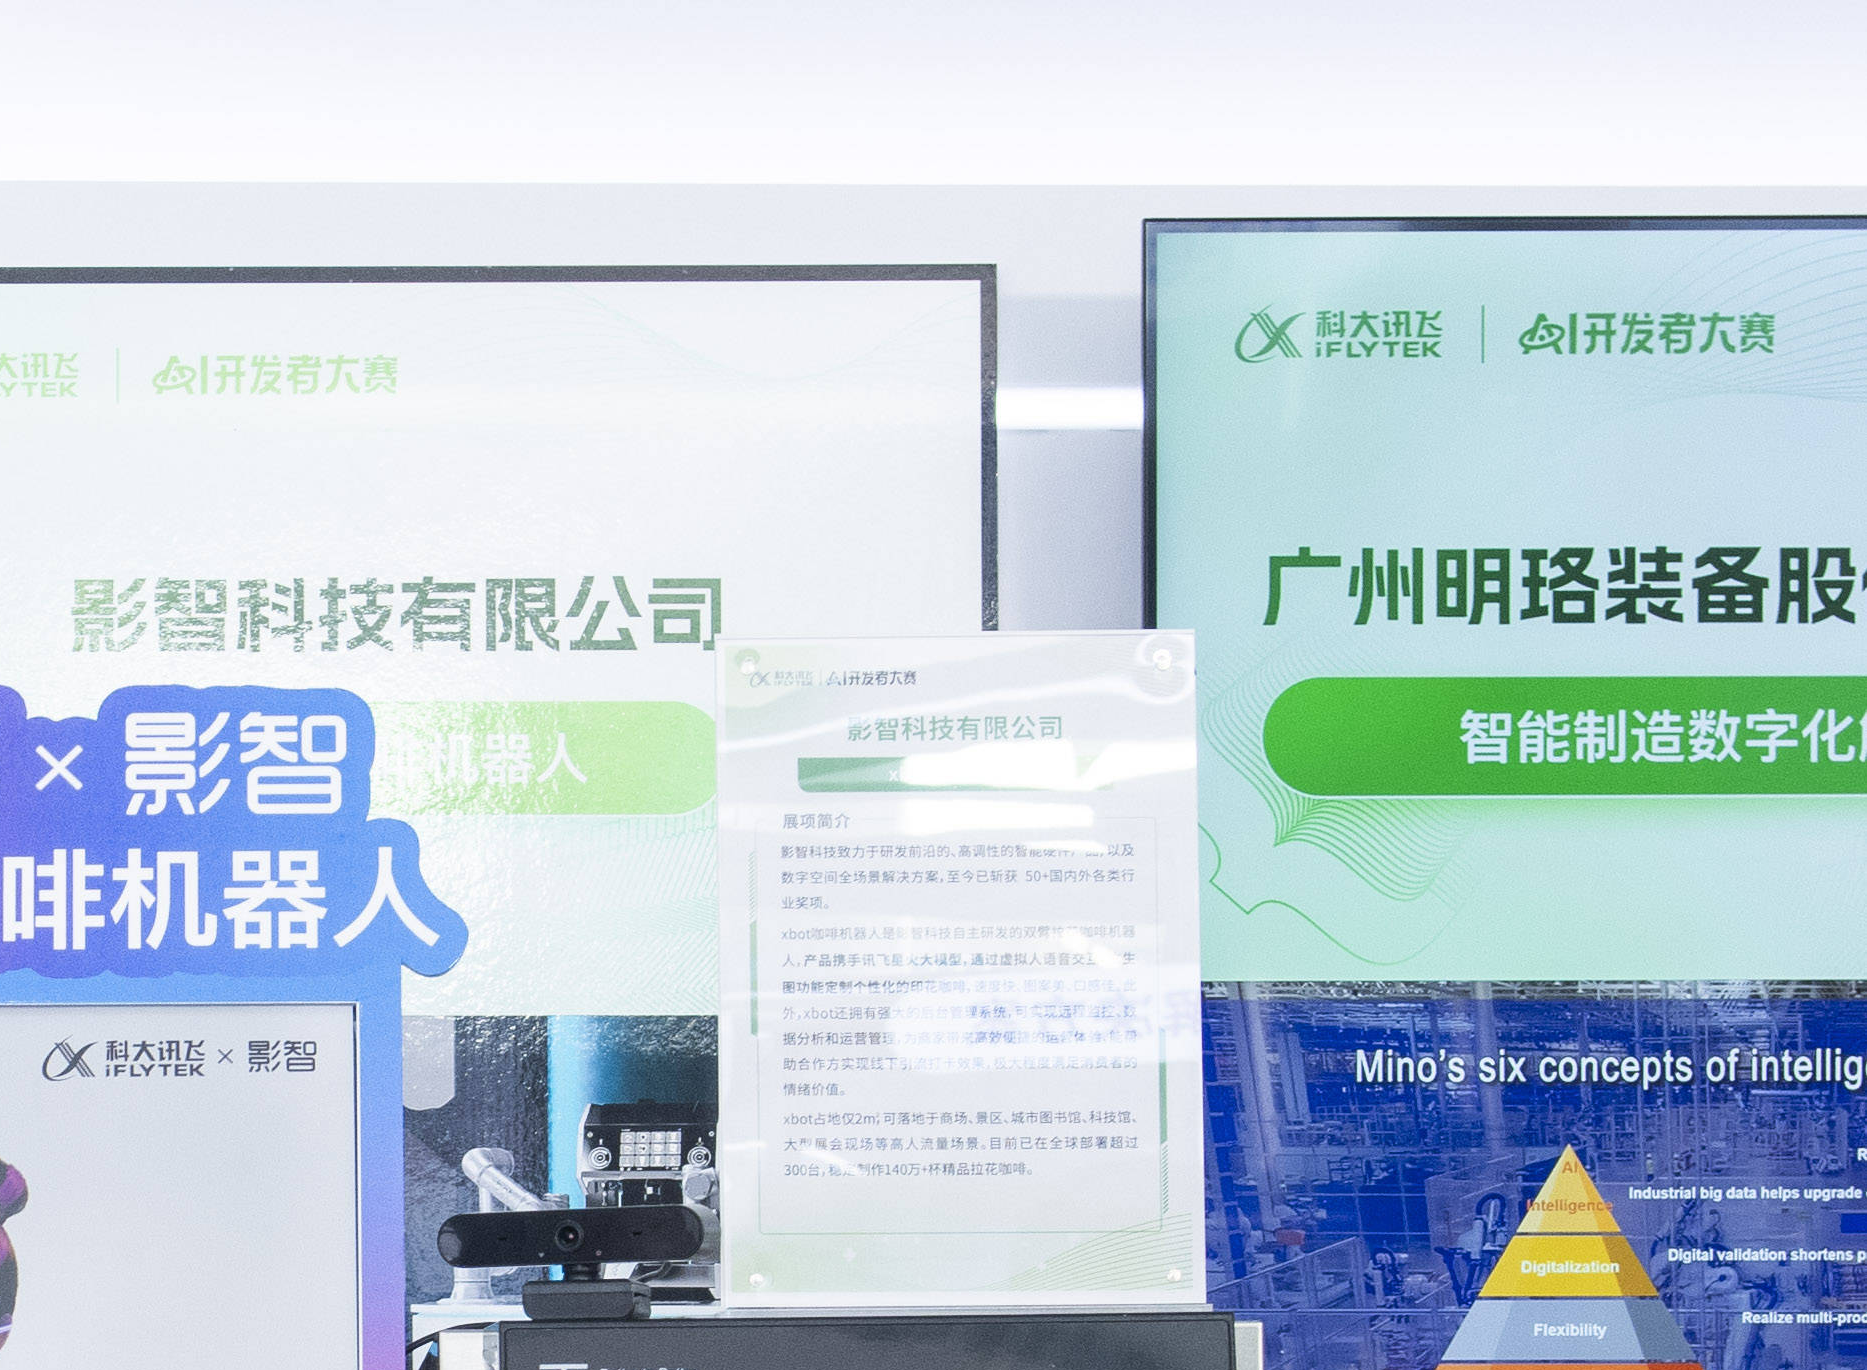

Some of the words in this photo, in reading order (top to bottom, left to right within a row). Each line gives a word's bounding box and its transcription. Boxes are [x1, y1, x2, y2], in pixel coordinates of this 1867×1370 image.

[1316, 310, 1443, 340] 科大讯飞
[1519, 312, 1776, 356] AI开发者大赛
[1263, 545, 1867, 627] 广州明珞装备股
[69, 574, 722, 653] 影智科技有限公司
[847, 714, 1064, 742] 影智科技有限公司
[1460, 708, 1867, 765] 智能制造数字化
[124, 711, 347, 817] 影智
[782, 812, 851, 830] 展项简介
[781, 895, 830, 910] 业奖项。
[105, 1038, 206, 1062] 科大讯飞
[247, 1039, 318, 1073] 影智
[1478, 1049, 1527, 1084] six
[1538, 1049, 1694, 1091] concepts
[1705, 1048, 1740, 1084] of
[1751, 1047, 1867, 1091] intellig
[782, 1082, 847, 1097] 情绪价值。
[1561, 1160, 1579, 1175] AI
[1628, 1185, 1696, 1201] Industrial
[1699, 1185, 1723, 1204] big
[1726, 1186, 1757, 1201] data
[1761, 1186, 1801, 1203] helps
[1804, 1186, 1863, 1203] upgrade
[1525, 1198, 1614, 1215] Intelligence
[1668, 1247, 1714, 1265] Digital
[1717, 1248, 1788, 1263] validation
[1790, 1248, 1854, 1263] shortens
[1521, 1259, 1620, 1277] Digitalization
[1741, 1311, 1794, 1325] Realize
[1533, 1323, 1607, 1340] Flexibility
